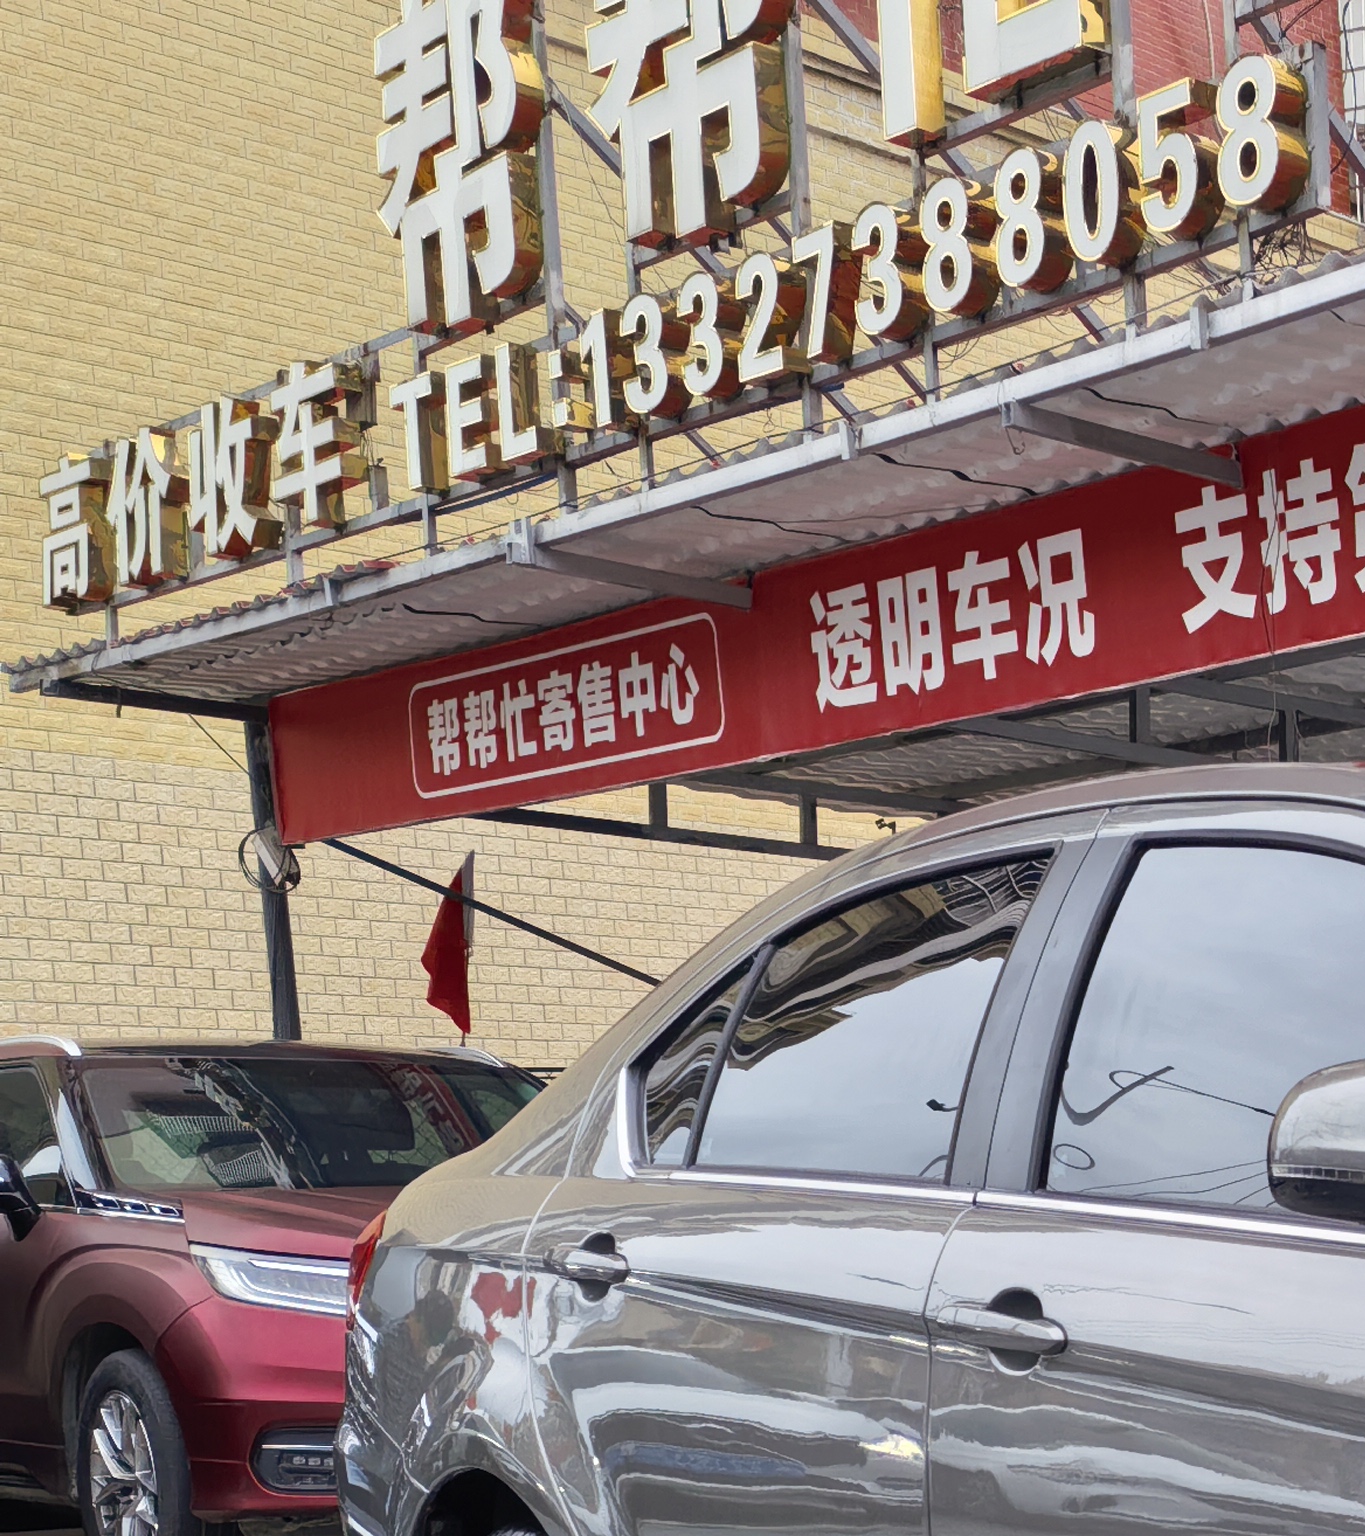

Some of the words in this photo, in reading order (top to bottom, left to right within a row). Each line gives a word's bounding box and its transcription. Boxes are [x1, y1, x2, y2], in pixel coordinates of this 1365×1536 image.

[40, 362, 360, 607] 高价收车
[427, 643, 700, 777] 帮帮忙寄售中心
[810, 528, 1096, 713] 透明车况
